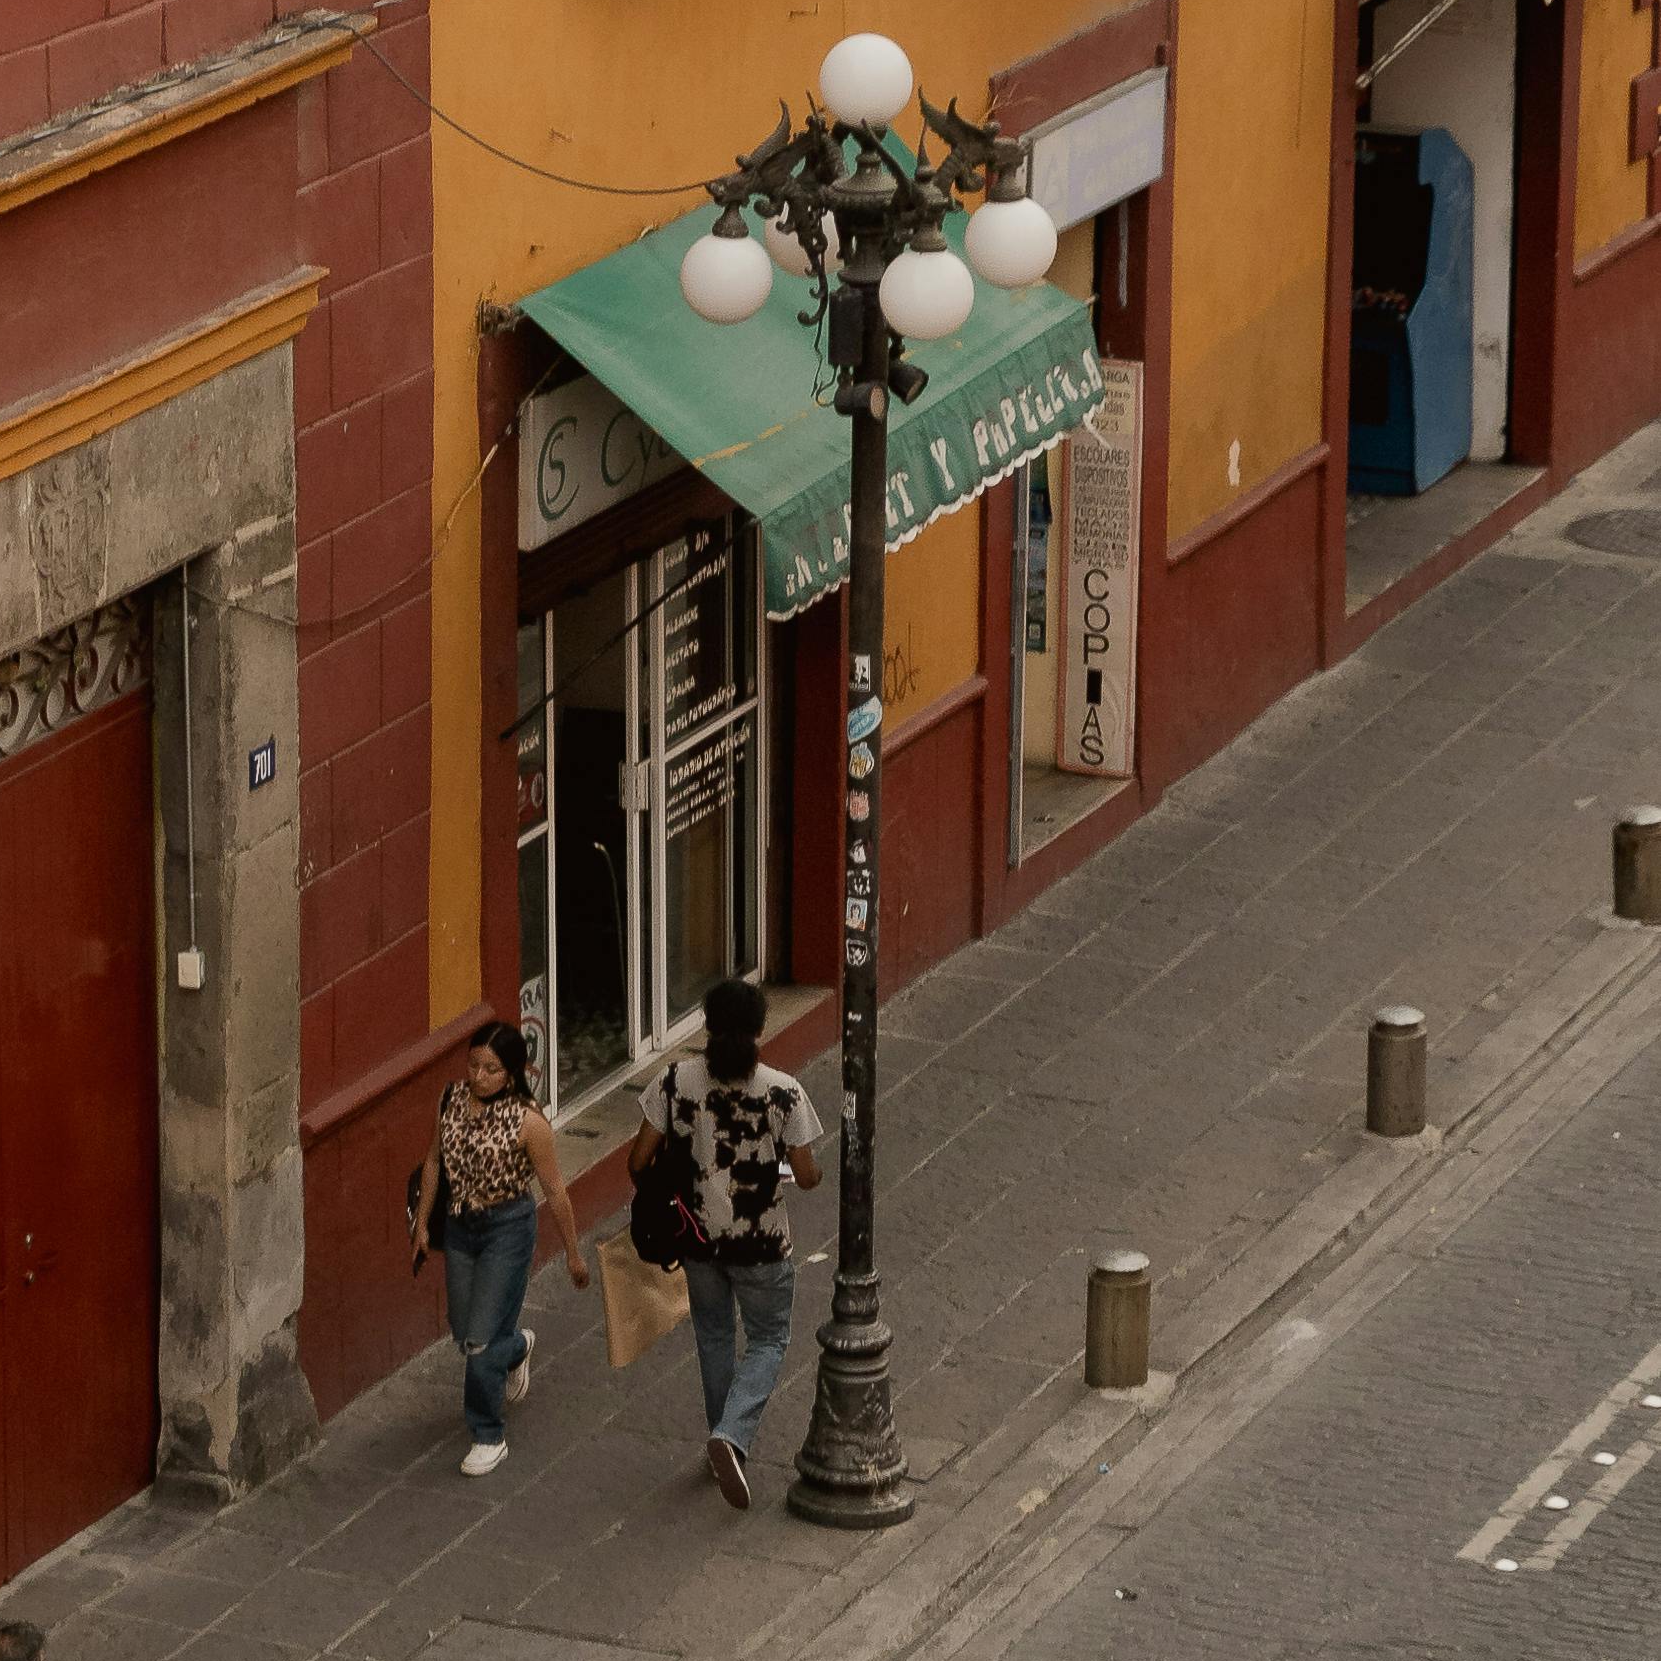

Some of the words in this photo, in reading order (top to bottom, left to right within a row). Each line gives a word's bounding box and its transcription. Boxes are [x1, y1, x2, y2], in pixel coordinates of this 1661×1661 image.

[930, 437, 955, 491] Y
[1074, 444, 1130, 468] ESCOLARES
[1074, 465, 1129, 488] DISPOSITIVOS
[1079, 568, 1111, 766] COPIAS
[666, 712, 688, 738] PAPEL
[254, 747, 271, 784] 701
[703, 746, 713, 768] DE
